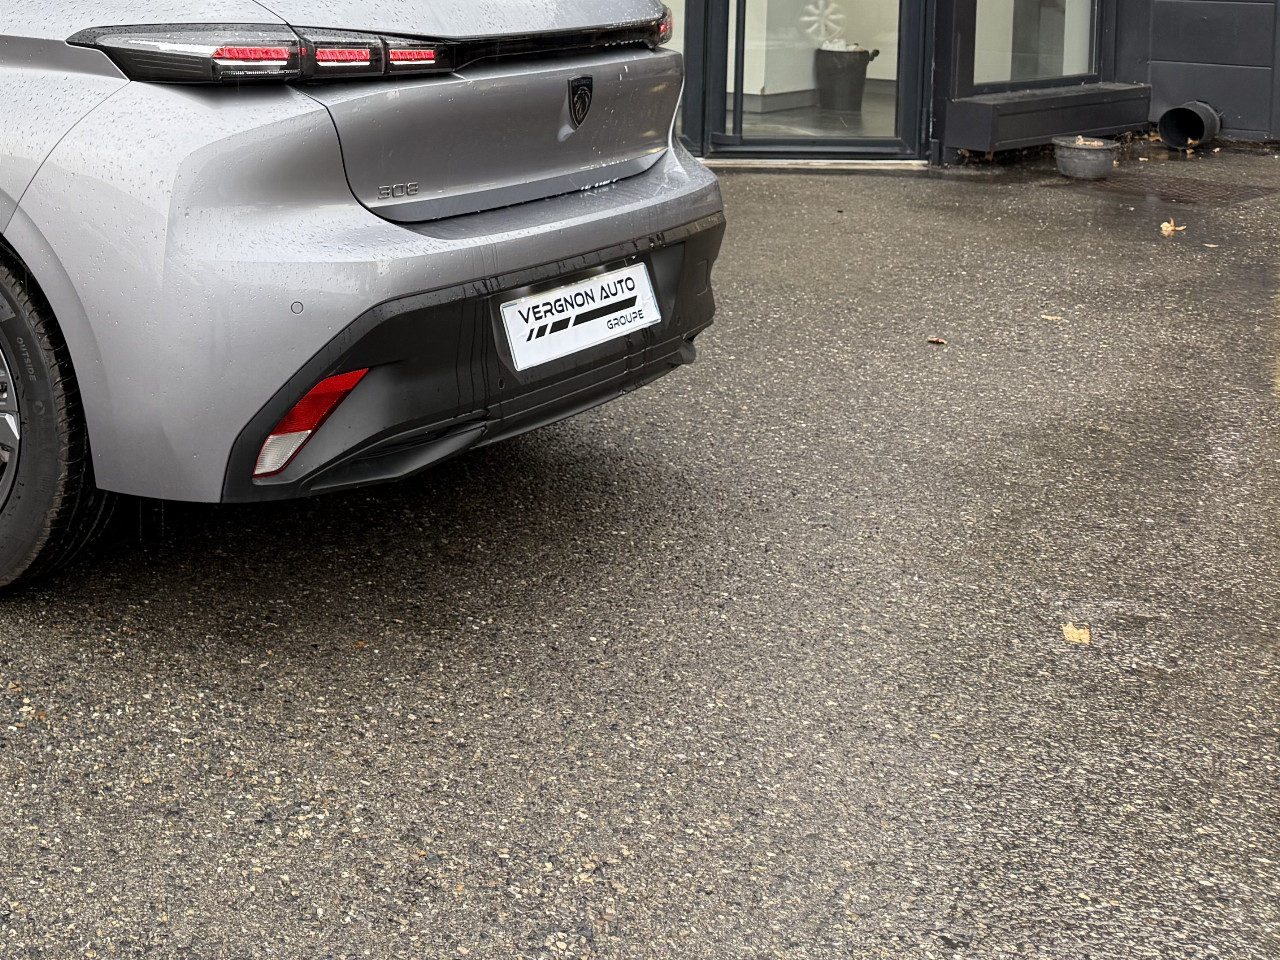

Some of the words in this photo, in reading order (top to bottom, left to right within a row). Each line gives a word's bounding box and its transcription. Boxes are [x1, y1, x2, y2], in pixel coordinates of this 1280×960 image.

[377, 181, 419, 200] 308
[517, 288, 596, 324] VERGNON
[599, 276, 636, 301] AUTO
[606, 308, 645, 330] GROUPE
[16, 336, 37, 382] OUTSIDE
